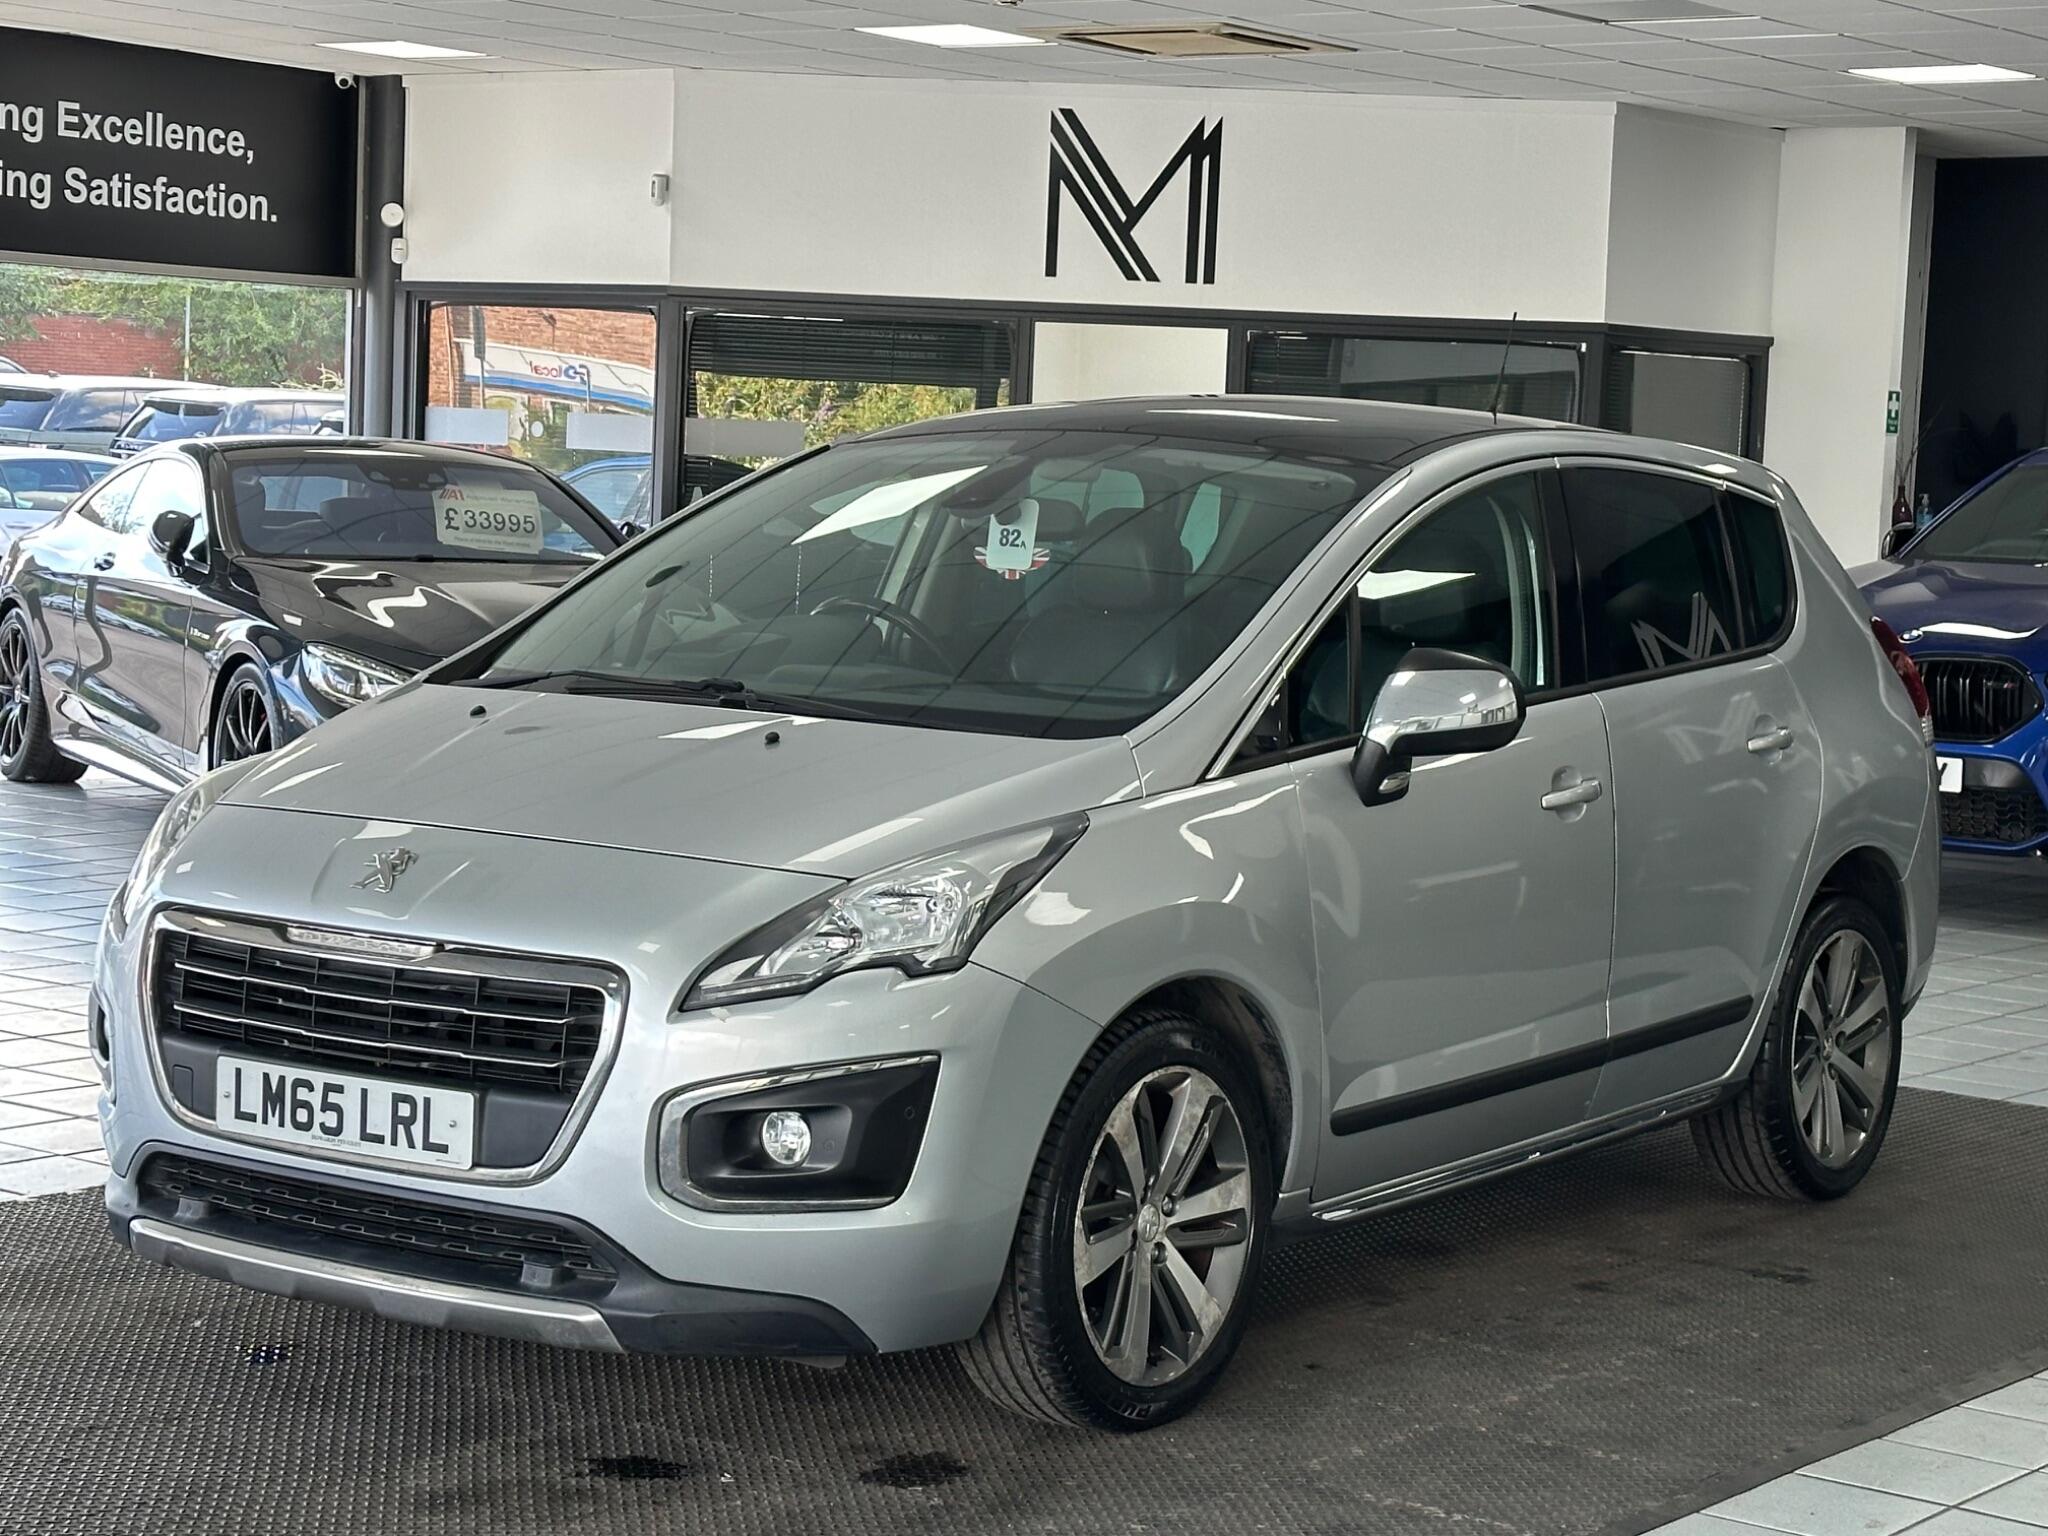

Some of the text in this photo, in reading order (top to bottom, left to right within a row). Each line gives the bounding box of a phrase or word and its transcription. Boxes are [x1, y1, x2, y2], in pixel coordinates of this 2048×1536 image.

[57, 100, 254, 164] Excellence,
[63, 166, 278, 222] Satisfaction.
[444, 507, 536, 534] £33995
[234, 1067, 449, 1154] LM65 LRL
